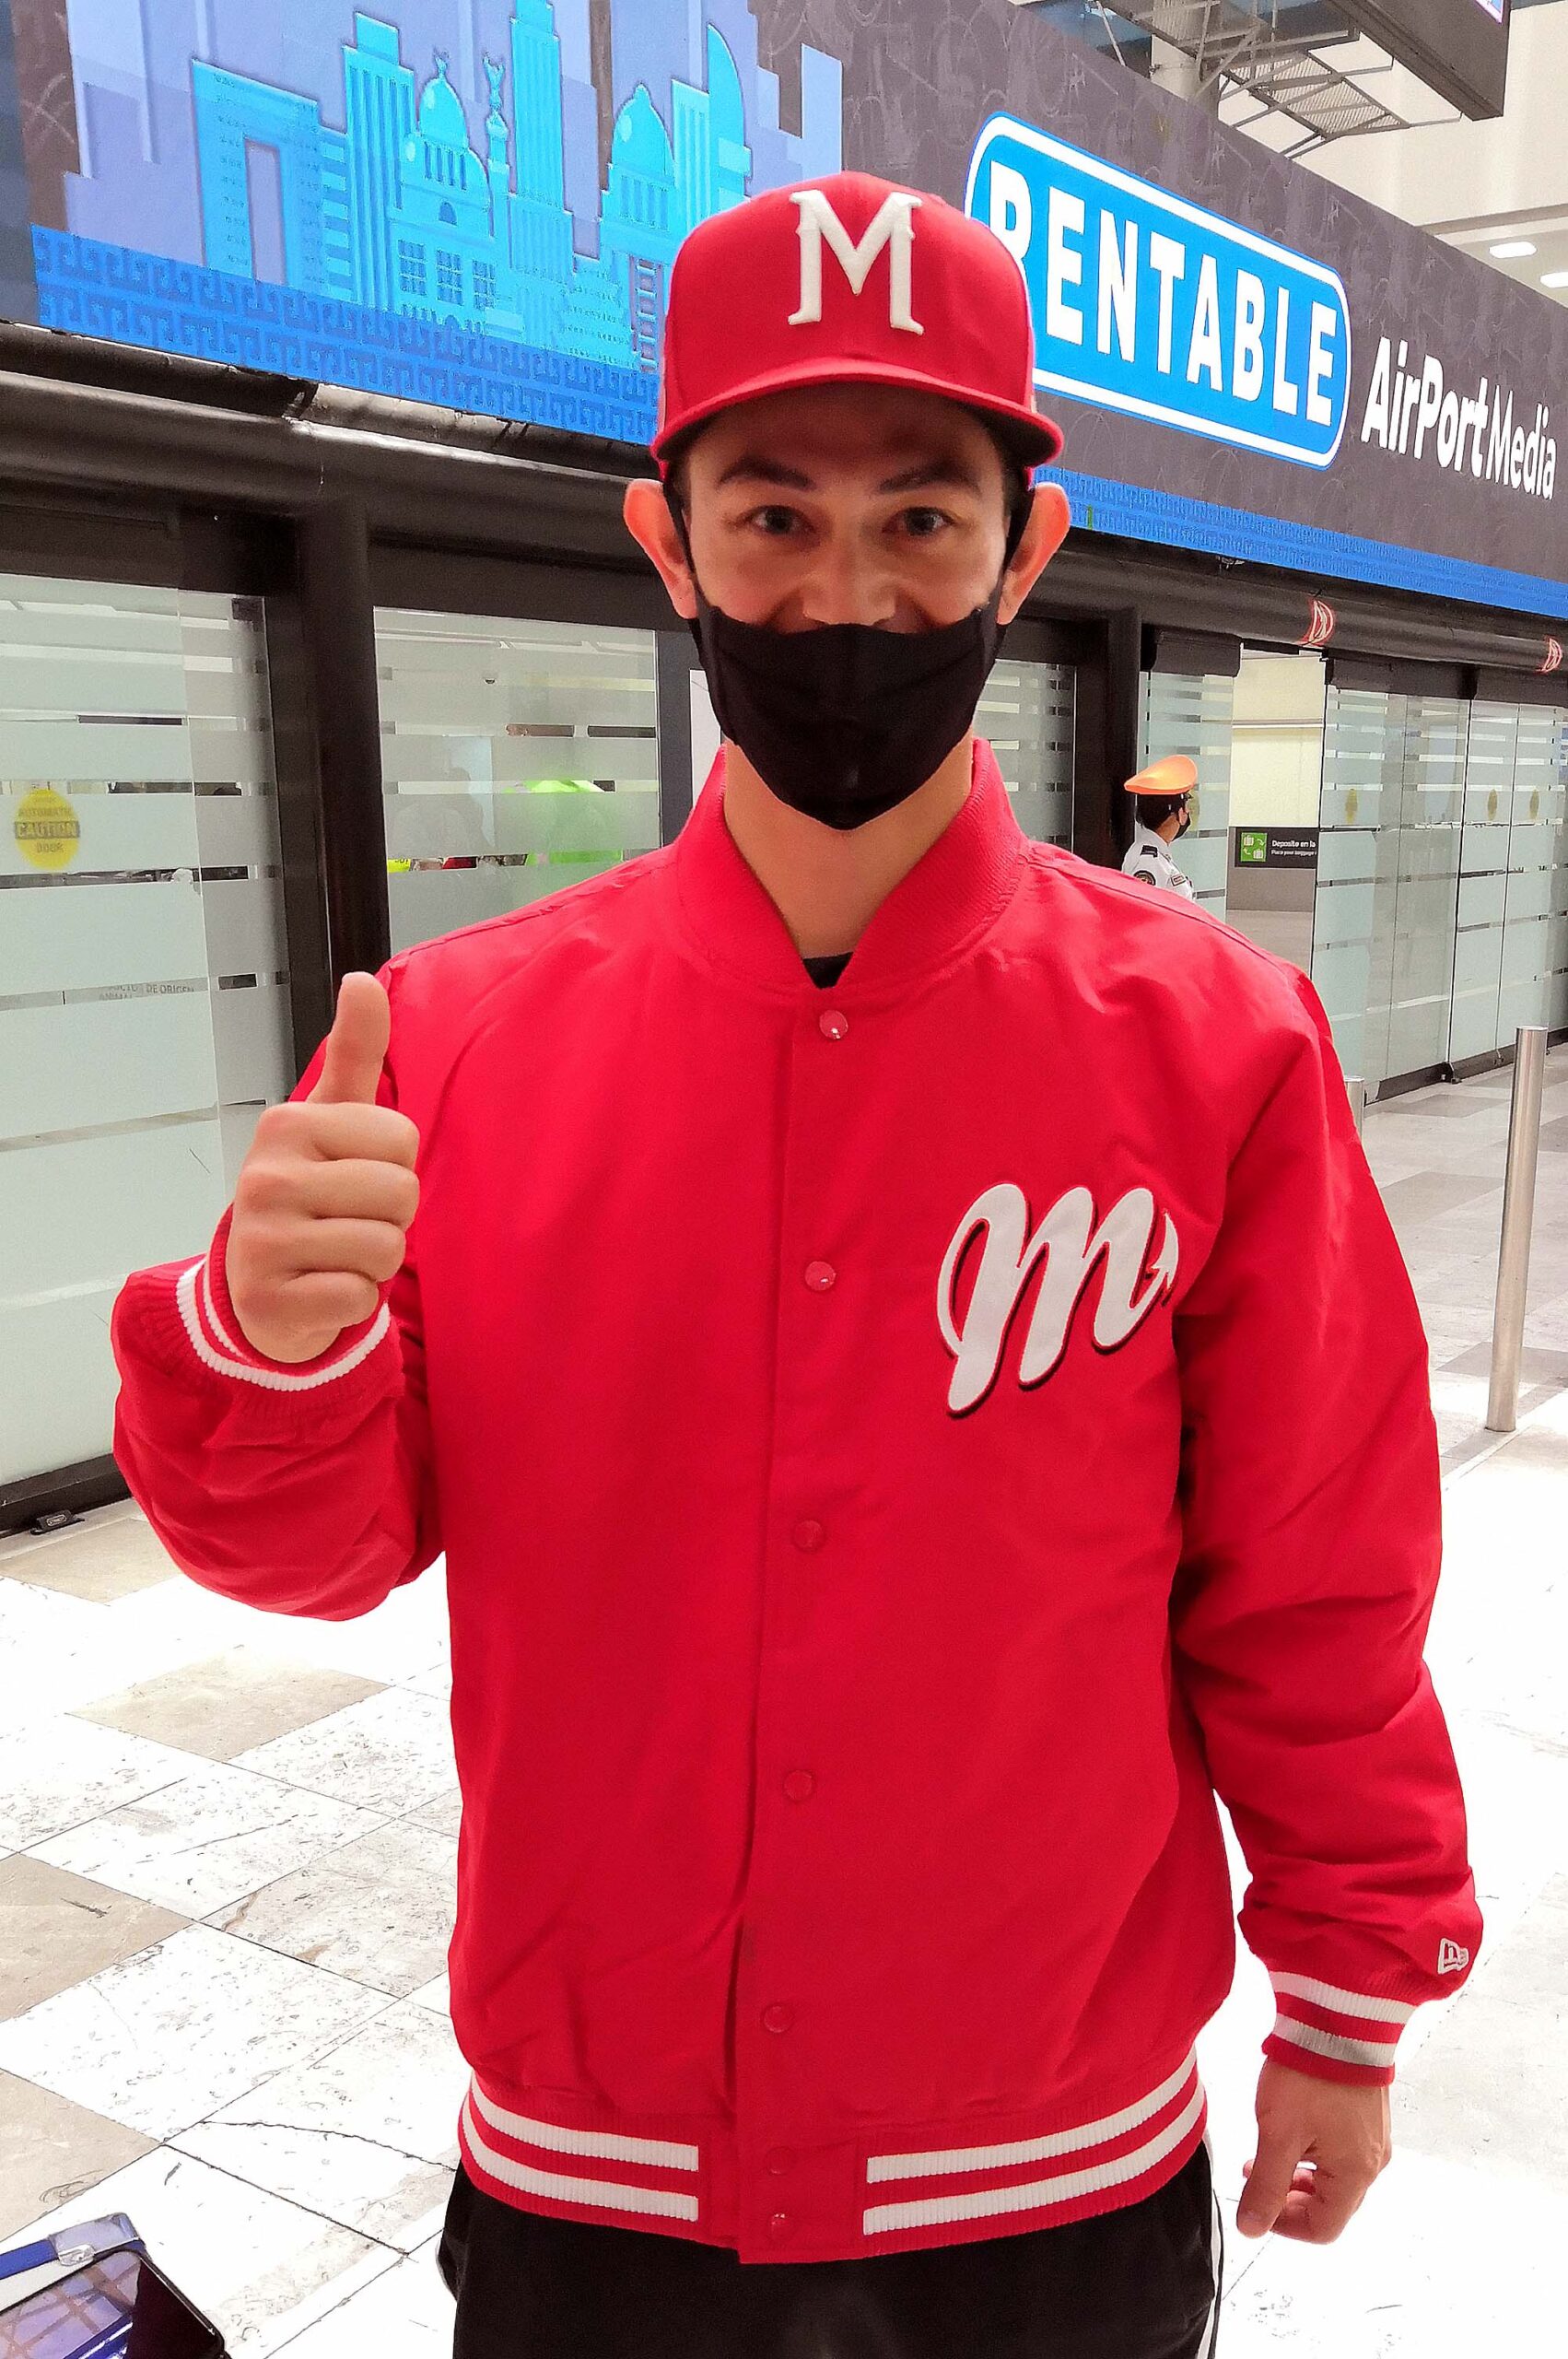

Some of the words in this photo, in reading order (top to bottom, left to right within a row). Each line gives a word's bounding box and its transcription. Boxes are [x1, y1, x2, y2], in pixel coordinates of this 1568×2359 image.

[788, 189, 924, 335] M
[989, 159, 1340, 427] RENTABLE
[1361, 337, 1489, 478] AirPort
[1486, 384, 1557, 500] Media
[18, 822, 78, 839] CAUTION
